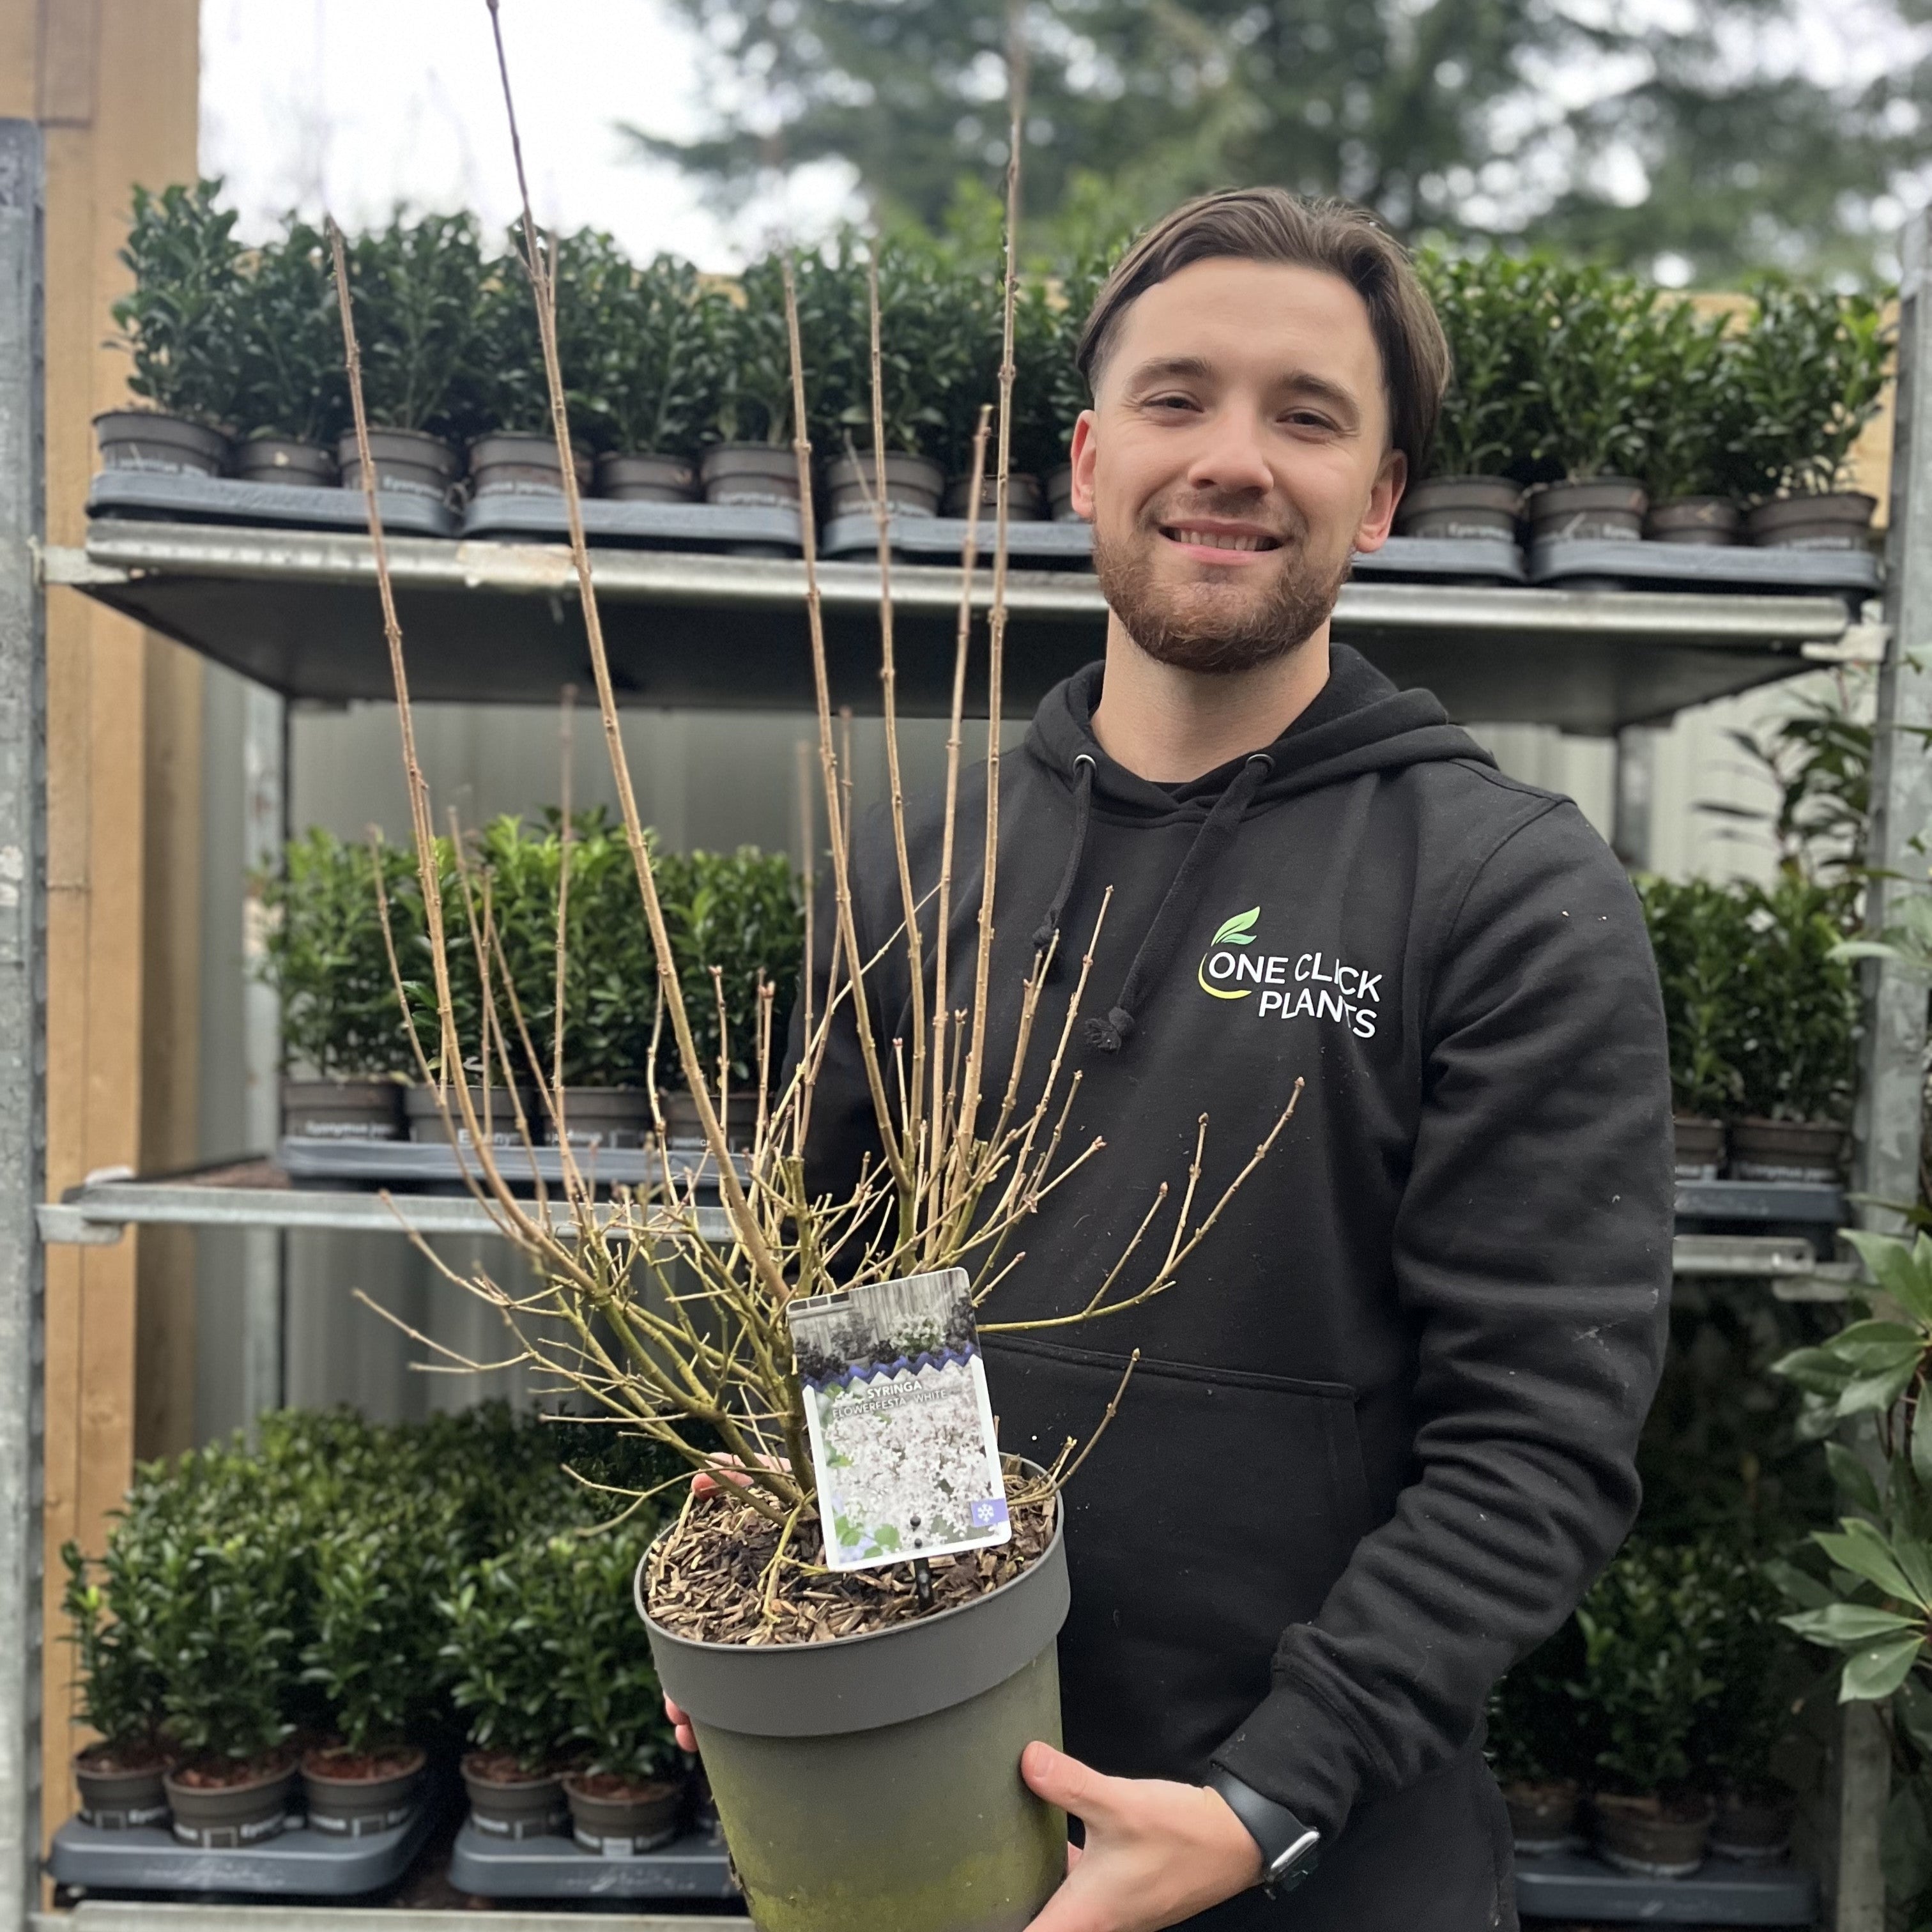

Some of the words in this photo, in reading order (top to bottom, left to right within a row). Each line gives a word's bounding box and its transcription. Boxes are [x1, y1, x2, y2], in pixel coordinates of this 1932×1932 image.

[1209, 951, 1289, 984] ONE
[1294, 952, 1383, 1002] CLICK
[1259, 988, 1377, 1038] PLANTS
[832, 1397, 907, 1418] FLOWERFESTA
[914, 1389, 947, 1404] WHITE
[867, 1380, 923, 1399] SYRINGA
